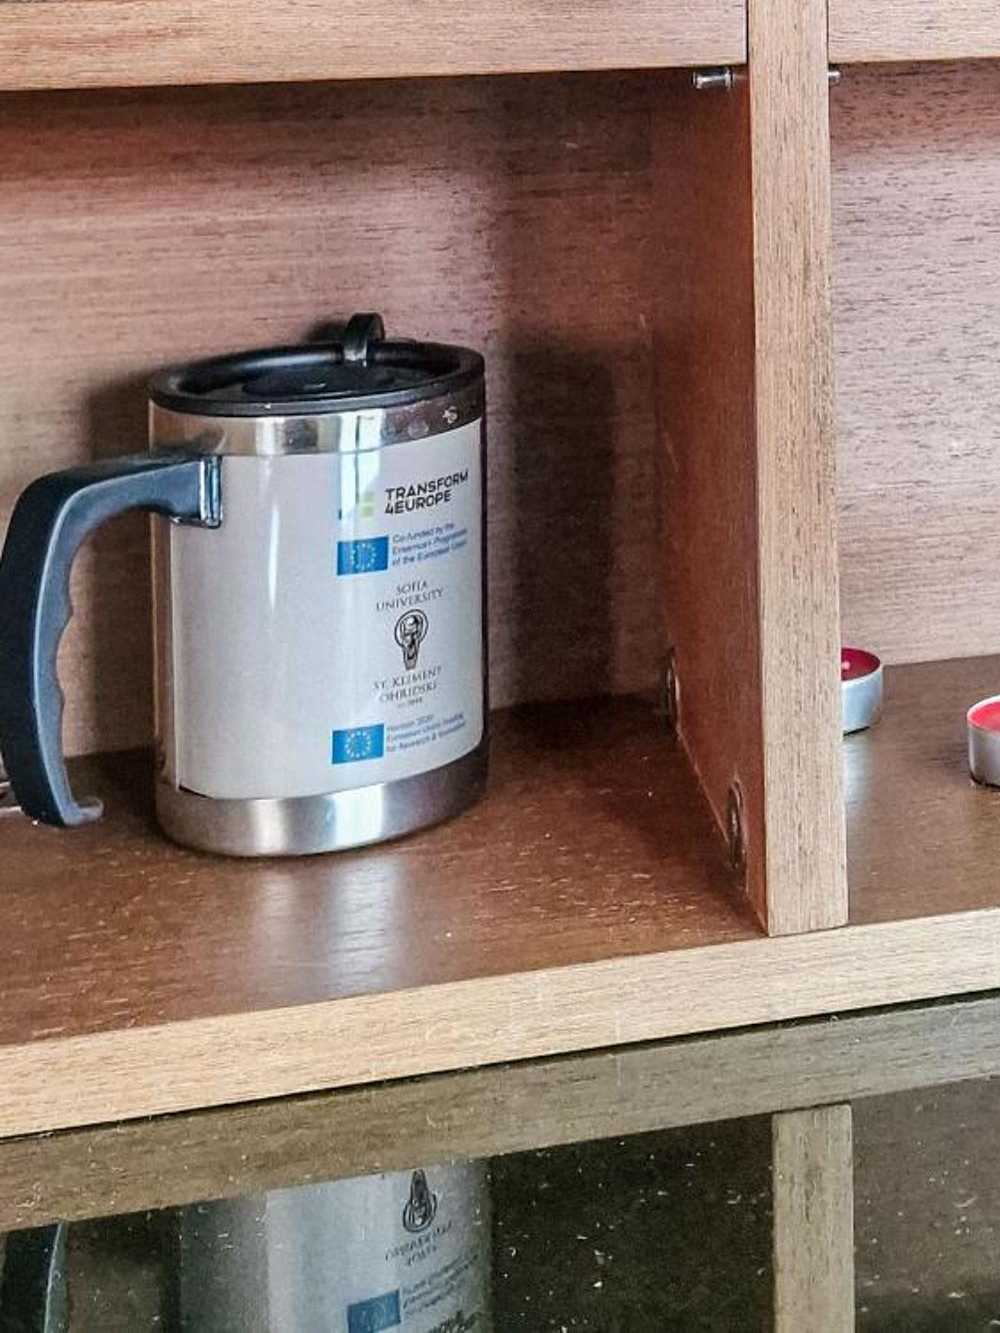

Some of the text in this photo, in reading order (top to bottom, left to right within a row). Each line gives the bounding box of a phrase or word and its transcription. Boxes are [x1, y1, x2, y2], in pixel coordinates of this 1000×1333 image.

[384, 469, 468, 500] TRANSFORM
[384, 489, 452, 514] 4EUROPE
[376, 587, 443, 611] UNIVERSITY
